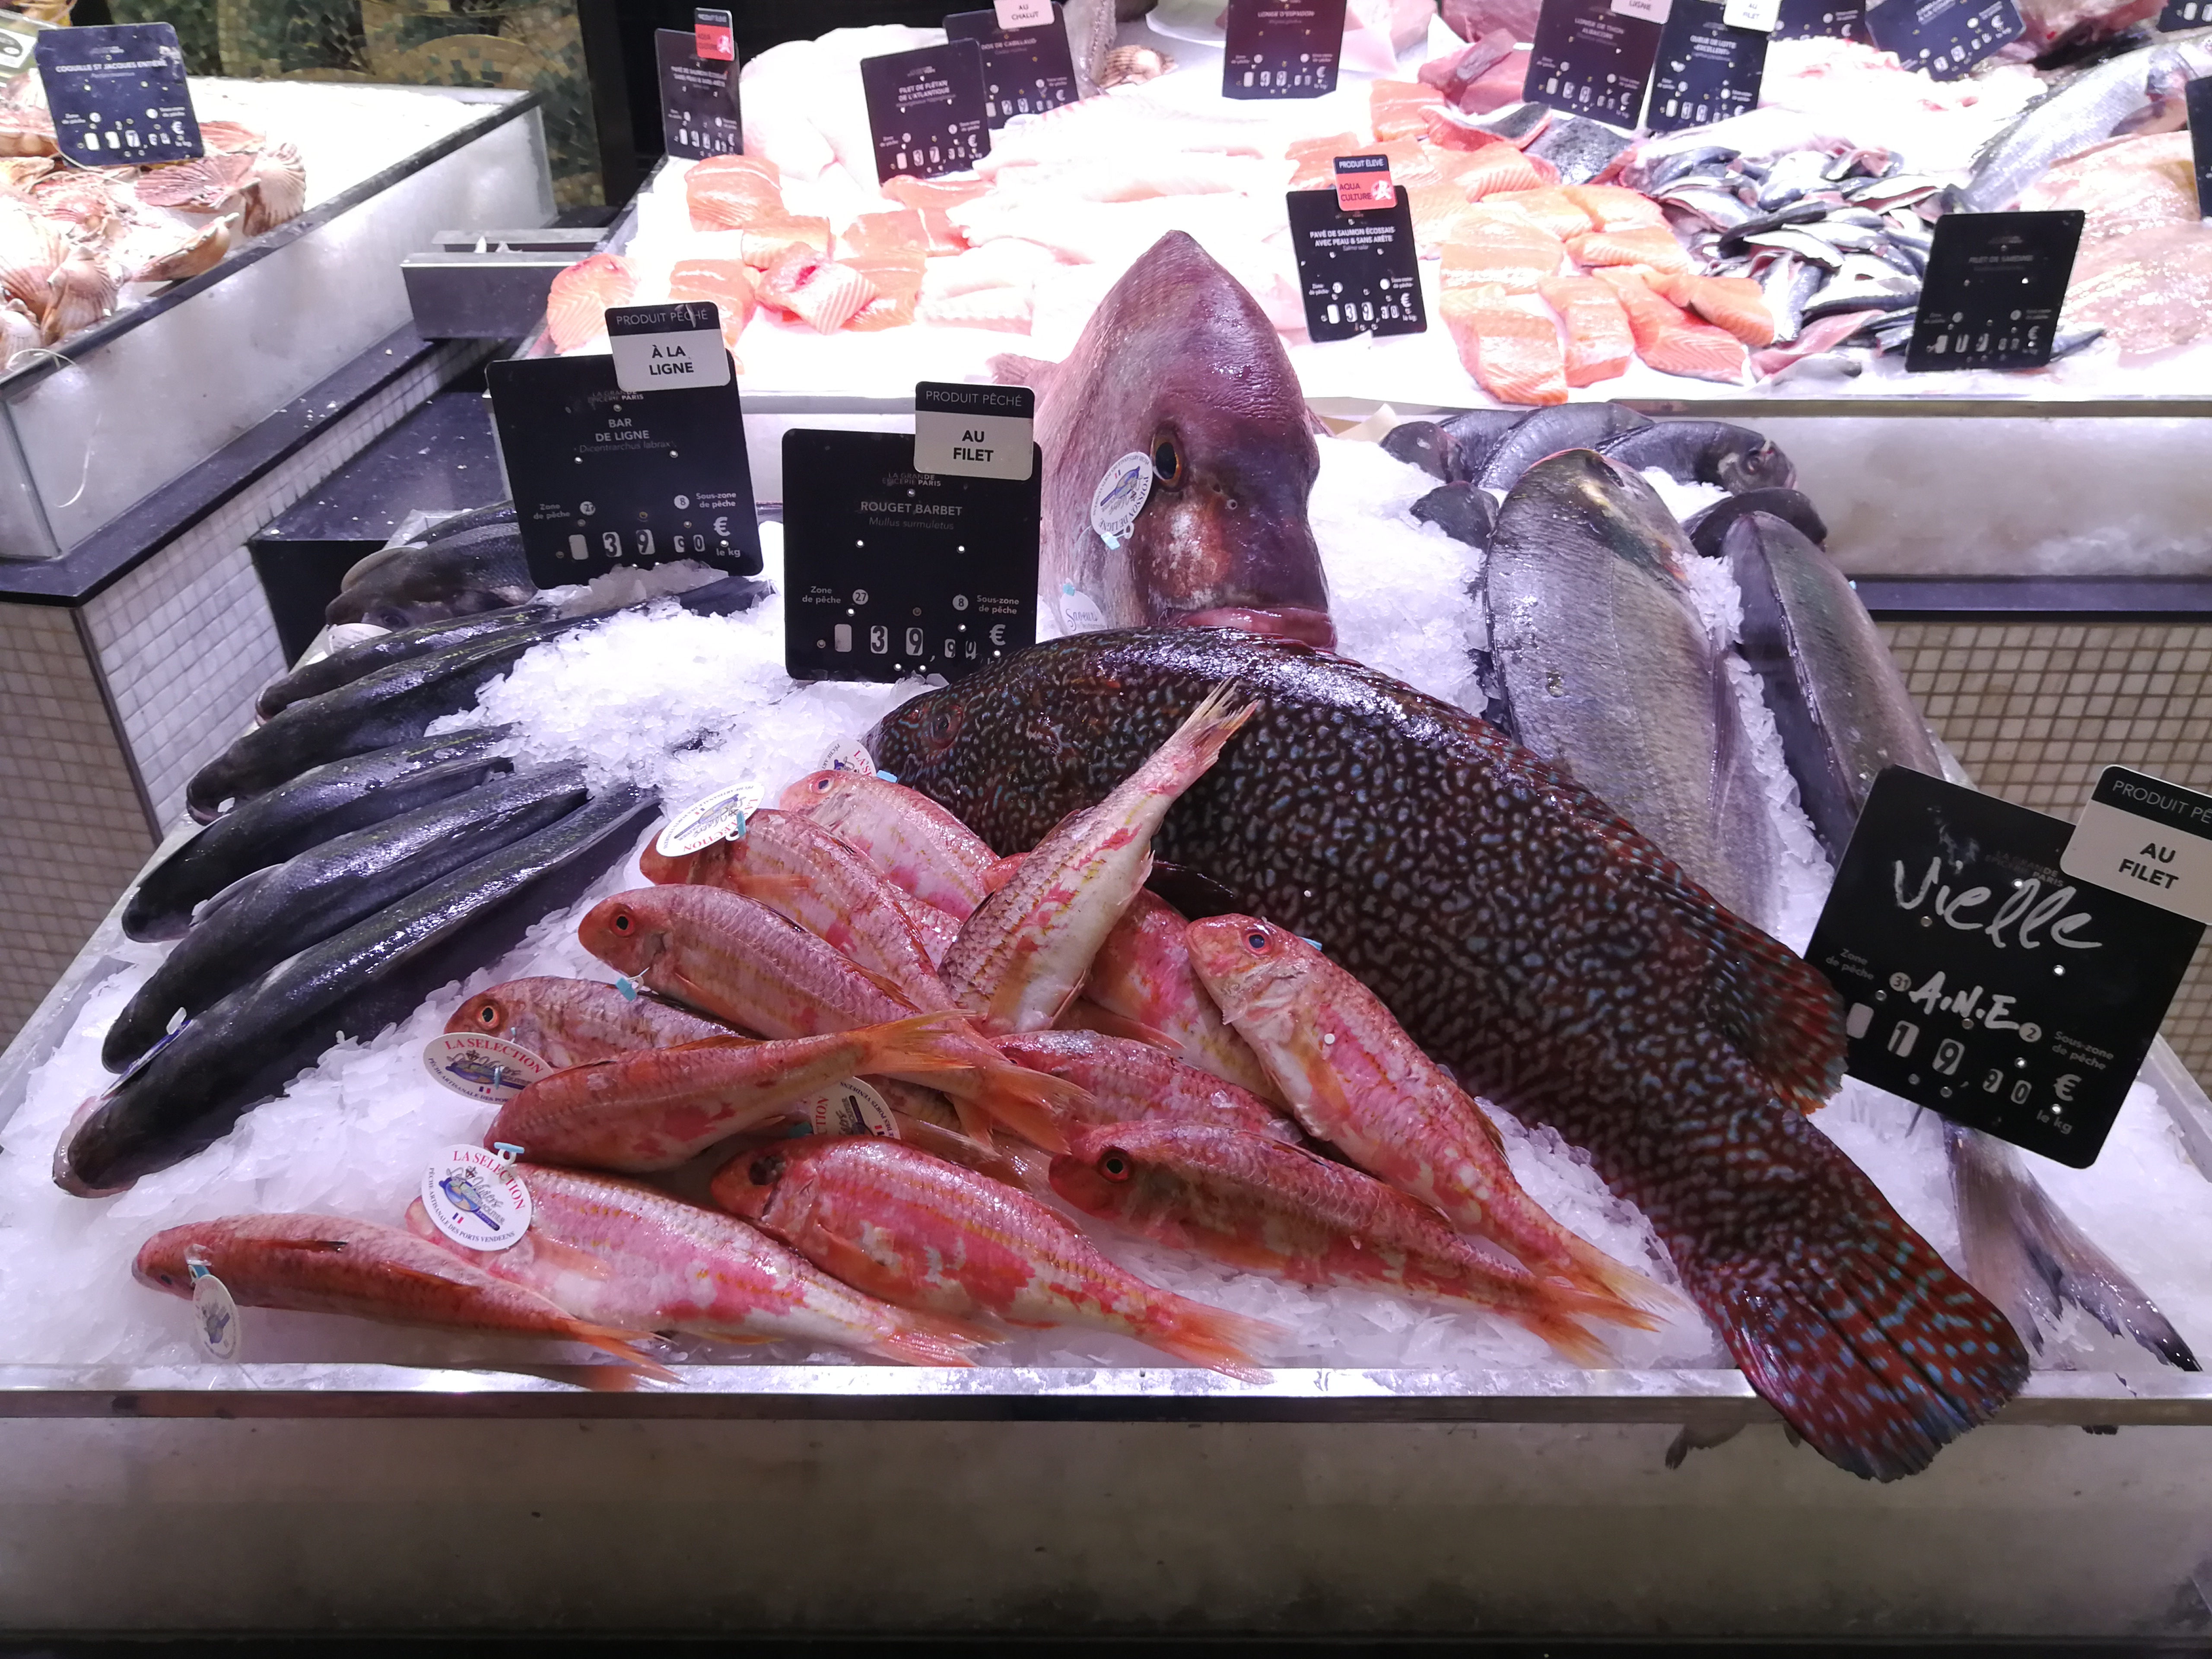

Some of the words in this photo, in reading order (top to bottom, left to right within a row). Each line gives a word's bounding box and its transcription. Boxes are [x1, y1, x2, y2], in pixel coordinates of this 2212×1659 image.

[1011, 11, 1039, 20] CHALUT
[1339, 160, 1364, 168] PRODUIT
[1341, 193, 1372, 202] CULTURE
[1309, 229, 1327, 238] PAVÉ
[1337, 228, 1365, 236] SAUMON
[1356, 236, 1373, 244] SANS
[1400, 292, 1412, 308] €
[616, 312, 666, 325] PRODUIT
[652, 344, 663, 358] À
[666, 346, 686, 358] LA
[649, 362, 694, 375] LIGNE
[925, 391, 979, 404] PRODUIT
[983, 393, 1023, 407] PÊCHÉ
[608, 418, 632, 428] BAR
[595, 432, 611, 442] DE
[615, 430, 650, 441] LIGNE
[962, 430, 985, 443] AU
[953, 448, 994, 462] FILET
[696, 492, 737, 500] Sous-zone
[1128, 476, 1149, 518] POISSON
[712, 500, 736, 509] pêche
[861, 501, 912, 513] ROUGET
[915, 504, 963, 516] BARBET
[713, 516, 731, 537] €
[869, 516, 900, 528] Mullus
[903, 520, 954, 531] surmuletus
[1098, 518, 1118, 531] LIGNE
[1118, 514, 1128, 526] DE
[716, 547, 725, 556] le
[726, 547, 741, 558] kg
[810, 586, 833, 594] Zone
[855, 592, 866, 602] 27
[802, 595, 813, 604] de
[815, 595, 841, 604] pêche
[976, 595, 1020, 605] Sous-zone
[979, 604, 990, 613] de
[992, 604, 1017, 615] pêche
[989, 624, 1006, 646] €
[2112, 780, 2189, 814] PRODUIT
[683, 812, 749, 852] SLECTION
[2139, 842, 2176, 863] AU
[2118, 858, 2180, 890] FILET
[1840, 948, 1868, 966] Zone
[1826, 956, 1840, 967] de
[1841, 963, 1875, 980] pêche
[2054, 1030, 2114, 1060] Sous-zone
[445, 1039, 465, 1050] LA
[467, 1038, 544, 1074] SELECTION
[2052, 1044, 2067, 1055] de
[2069, 1052, 2106, 1070] pêche
[2053, 1073, 2082, 1101] €
[2036, 1109, 2050, 1123] le
[2054, 1117, 2073, 1135] kg
[453, 1150, 469, 1161] LA
[472, 1152, 525, 1210] SELECTION
[428, 1190, 448, 1227] ARTISANALE
[448, 1224, 459, 1235] DES
[459, 1231, 480, 1242] PORTS
